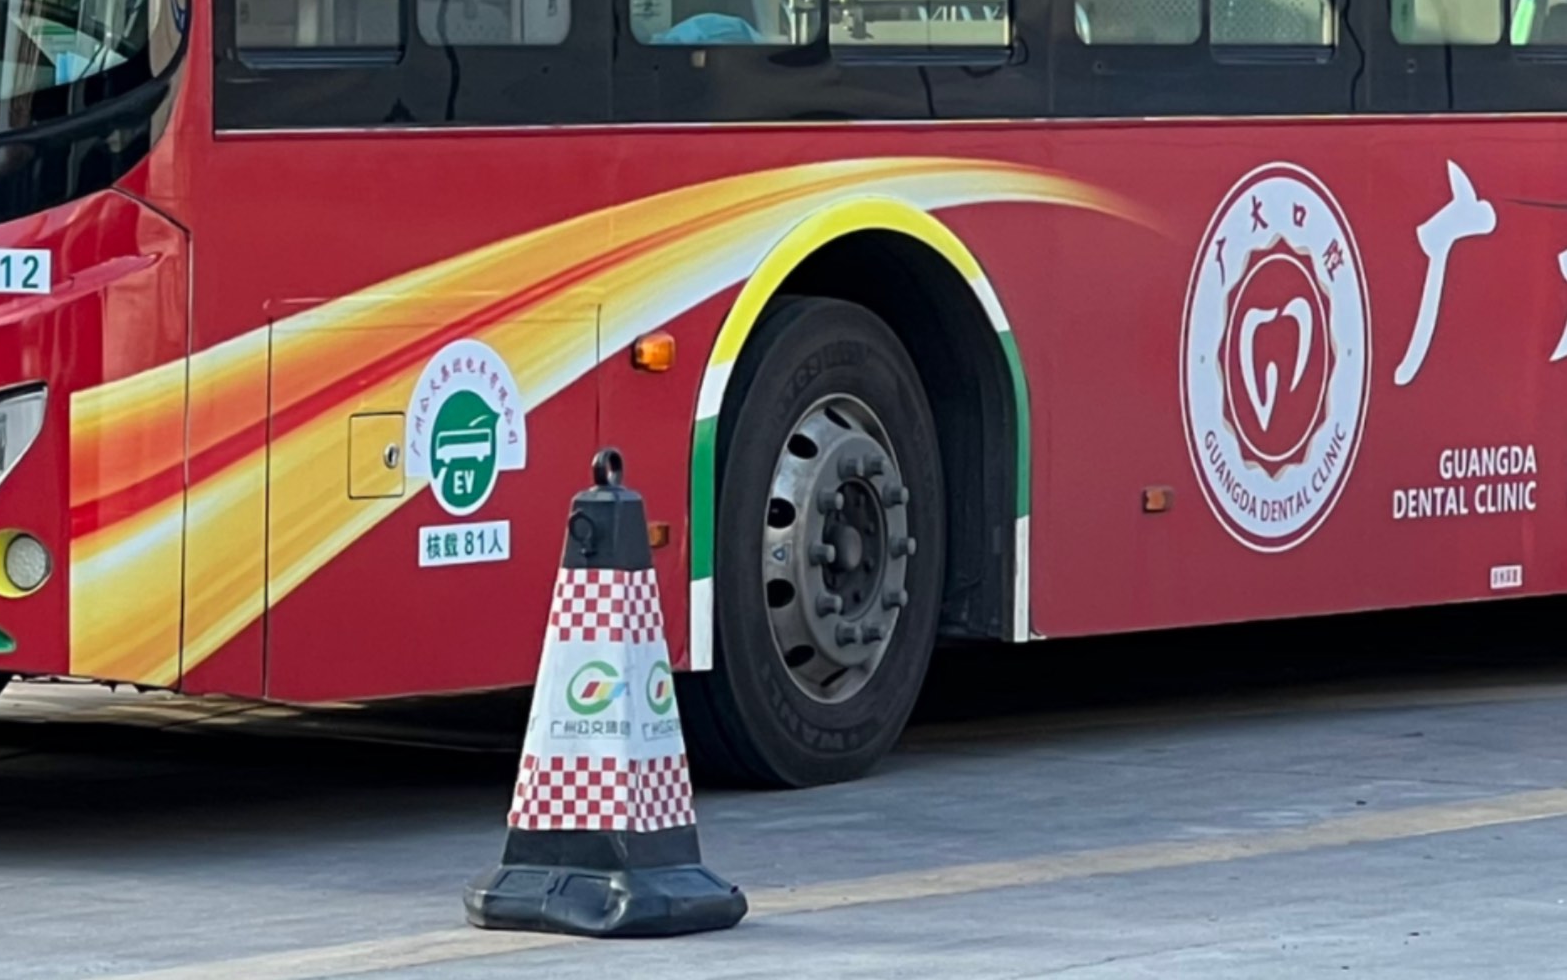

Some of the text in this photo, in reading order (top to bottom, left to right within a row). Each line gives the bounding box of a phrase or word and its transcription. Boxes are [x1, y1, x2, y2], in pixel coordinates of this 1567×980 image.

[1215, 195, 1345, 285] 广大口腔
[1204, 422, 1348, 522] GUANGDA DENTAL CLINIC
[1439, 445, 1537, 480] GUANGDA
[453, 470, 475, 495] EV
[1393, 481, 1537, 519] DENTAL CLINIC
[550, 720, 632, 738] 广州公交集团
